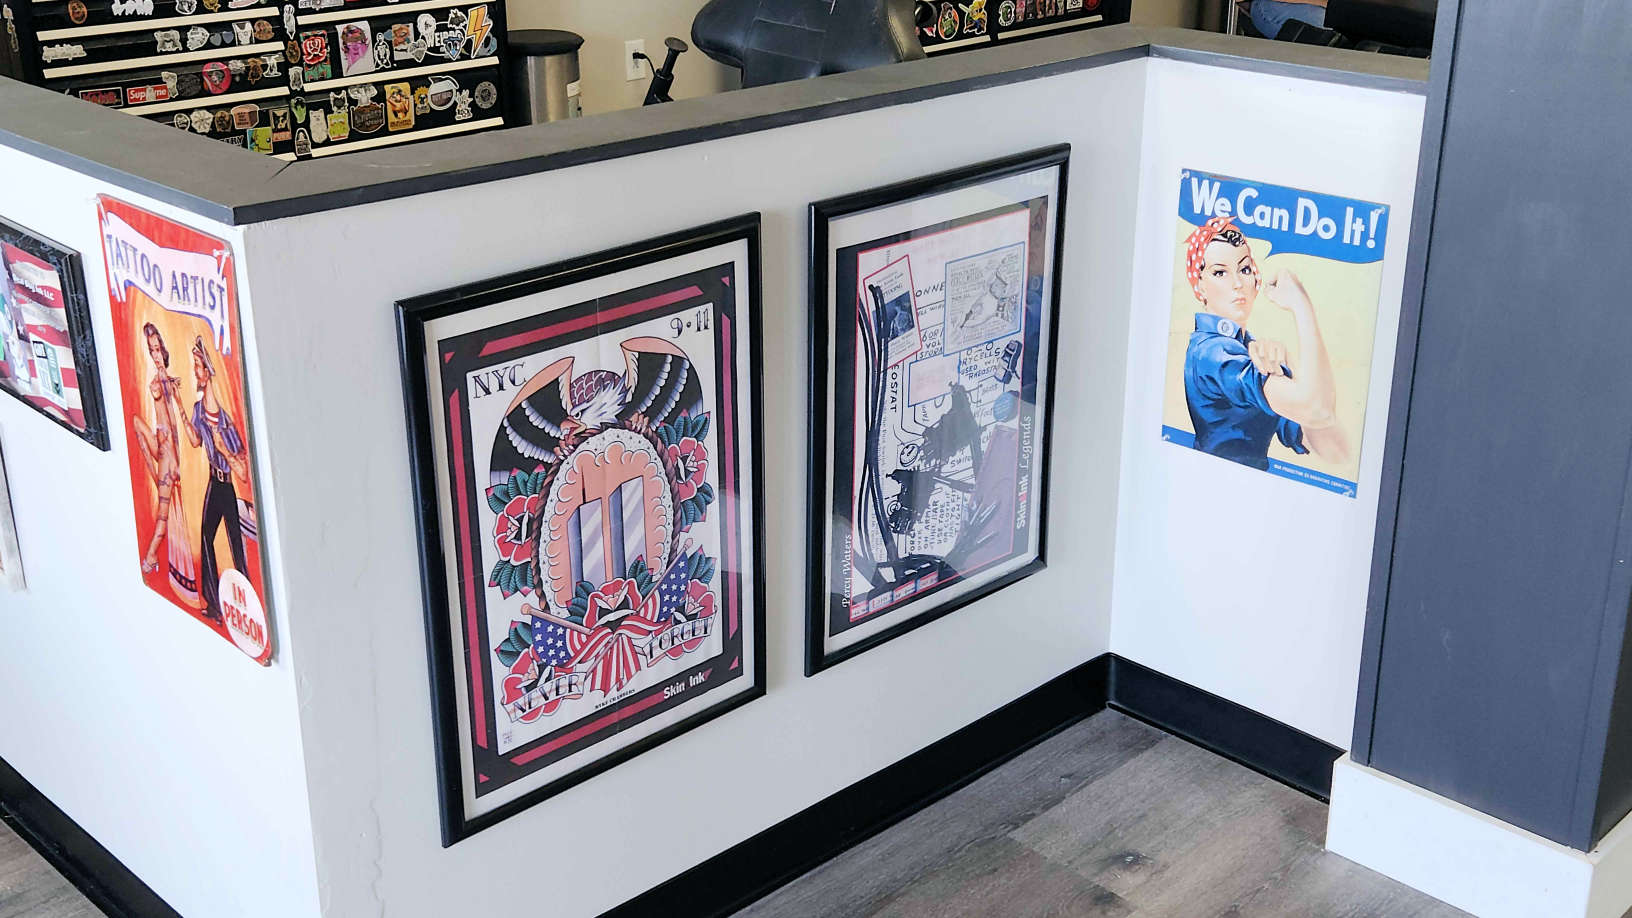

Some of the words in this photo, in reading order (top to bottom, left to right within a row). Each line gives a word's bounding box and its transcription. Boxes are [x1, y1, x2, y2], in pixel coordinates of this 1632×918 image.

[1190, 176, 1232, 218] We
[1236, 187, 1290, 232] Can
[1294, 197, 1337, 240] Do
[1342, 206, 1380, 249] It!
[106, 234, 163, 294] TATTOO
[171, 270, 226, 322] ARTIST
[472, 362, 527, 399] NYC
[1019, 415, 1032, 470] Legends
[1018, 474, 1029, 498] Ink
[1017, 500, 1027, 529] Skin
[842, 534, 852, 575] Waters
[232, 582, 247, 607] IN
[842, 577, 855, 608] Percy
[223, 600, 265, 647] PERSON
[648, 617, 712, 659] FORGET
[509, 674, 581, 718] NEVER
[663, 681, 686, 699] Skin
[689, 671, 705, 687] Ink
